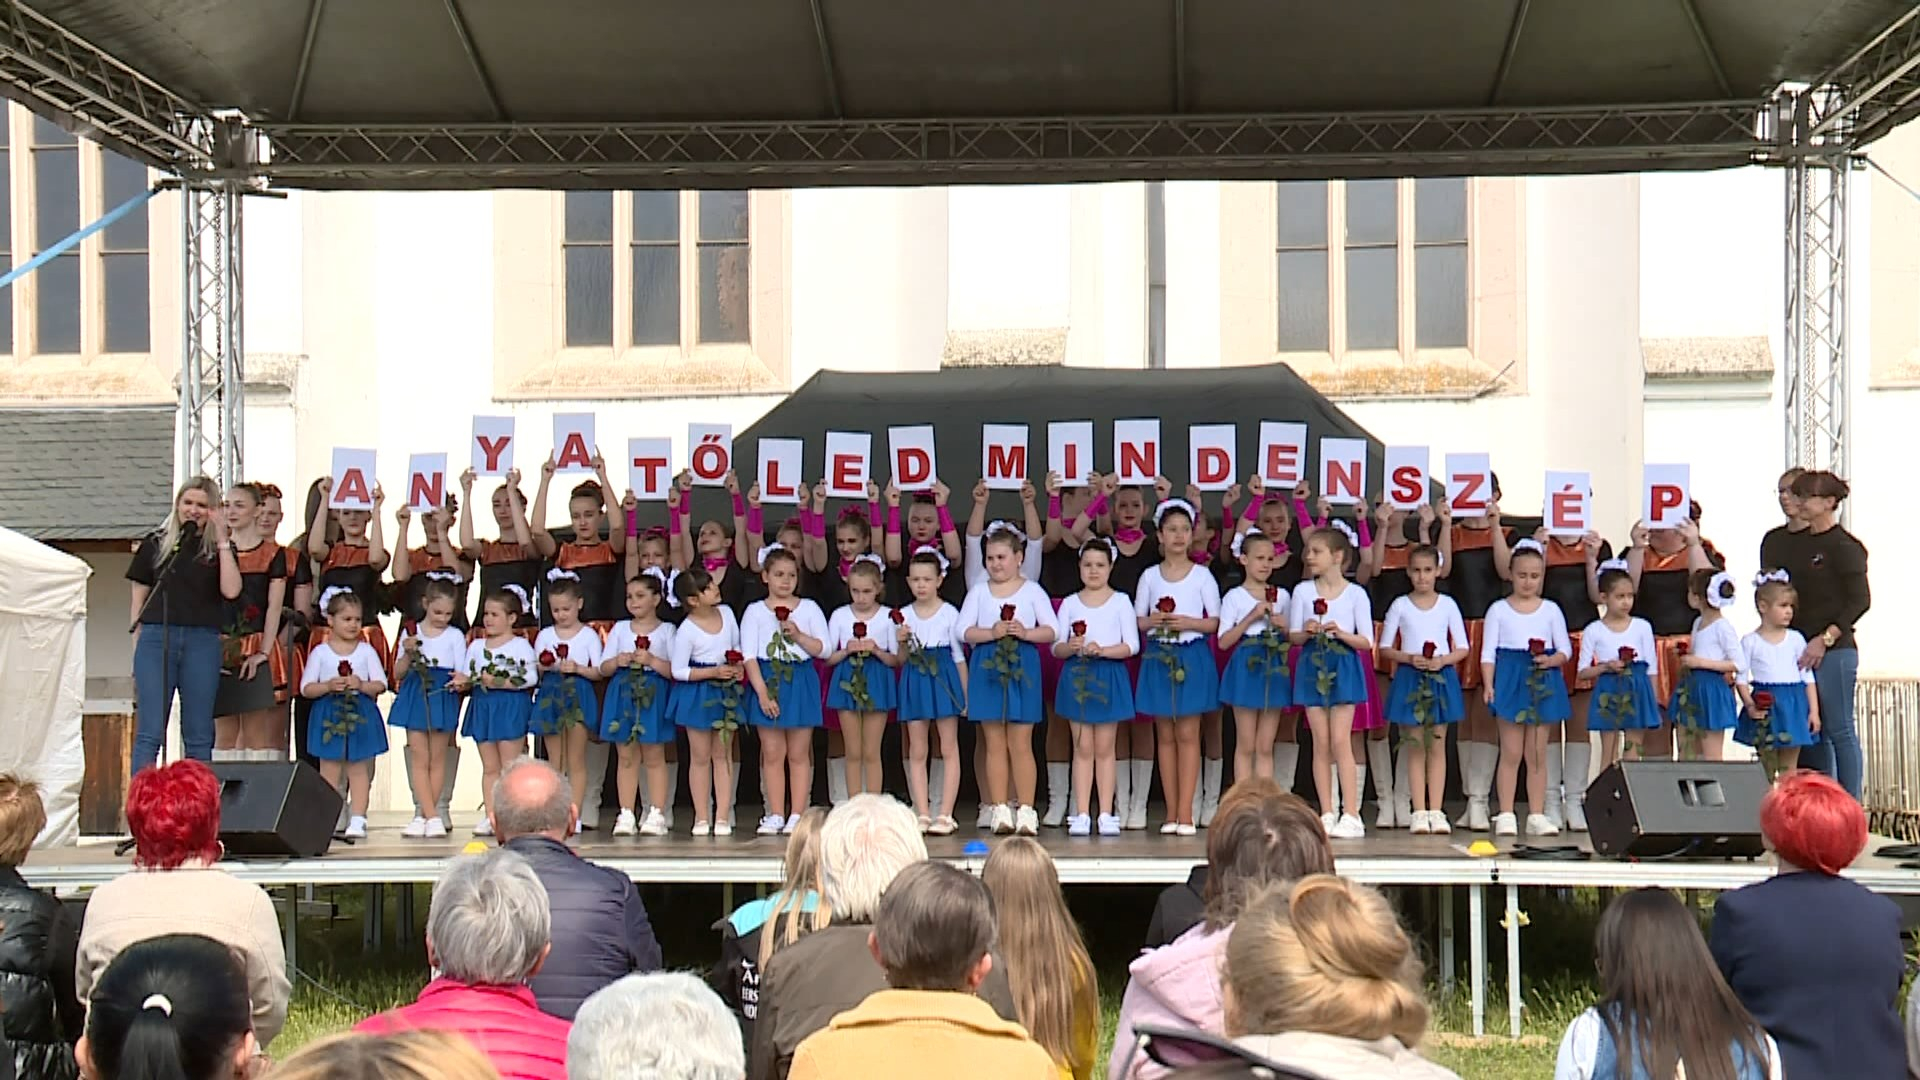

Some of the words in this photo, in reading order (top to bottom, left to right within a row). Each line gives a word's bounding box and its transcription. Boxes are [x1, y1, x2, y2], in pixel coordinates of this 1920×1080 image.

[335, 469, 370, 503] A
[410, 472, 442, 507] N
[479, 436, 509, 471] Y
[558, 432, 592, 468] A
[634, 458, 667, 492] T
[692, 434, 728, 480] Ő
[767, 460, 794, 496] L
[833, 454, 863, 491] E
[898, 448, 930, 484] D
[988, 444, 1025, 479] M
[1121, 442, 1155, 479] N
[1198, 447, 1230, 483] D
[1267, 444, 1298, 480] E
[1327, 460, 1361, 497] N
[1392, 466, 1423, 503] S
[1452, 474, 1488, 509] Z
[1553, 484, 1583, 527] É
[1651, 485, 1683, 521] P
